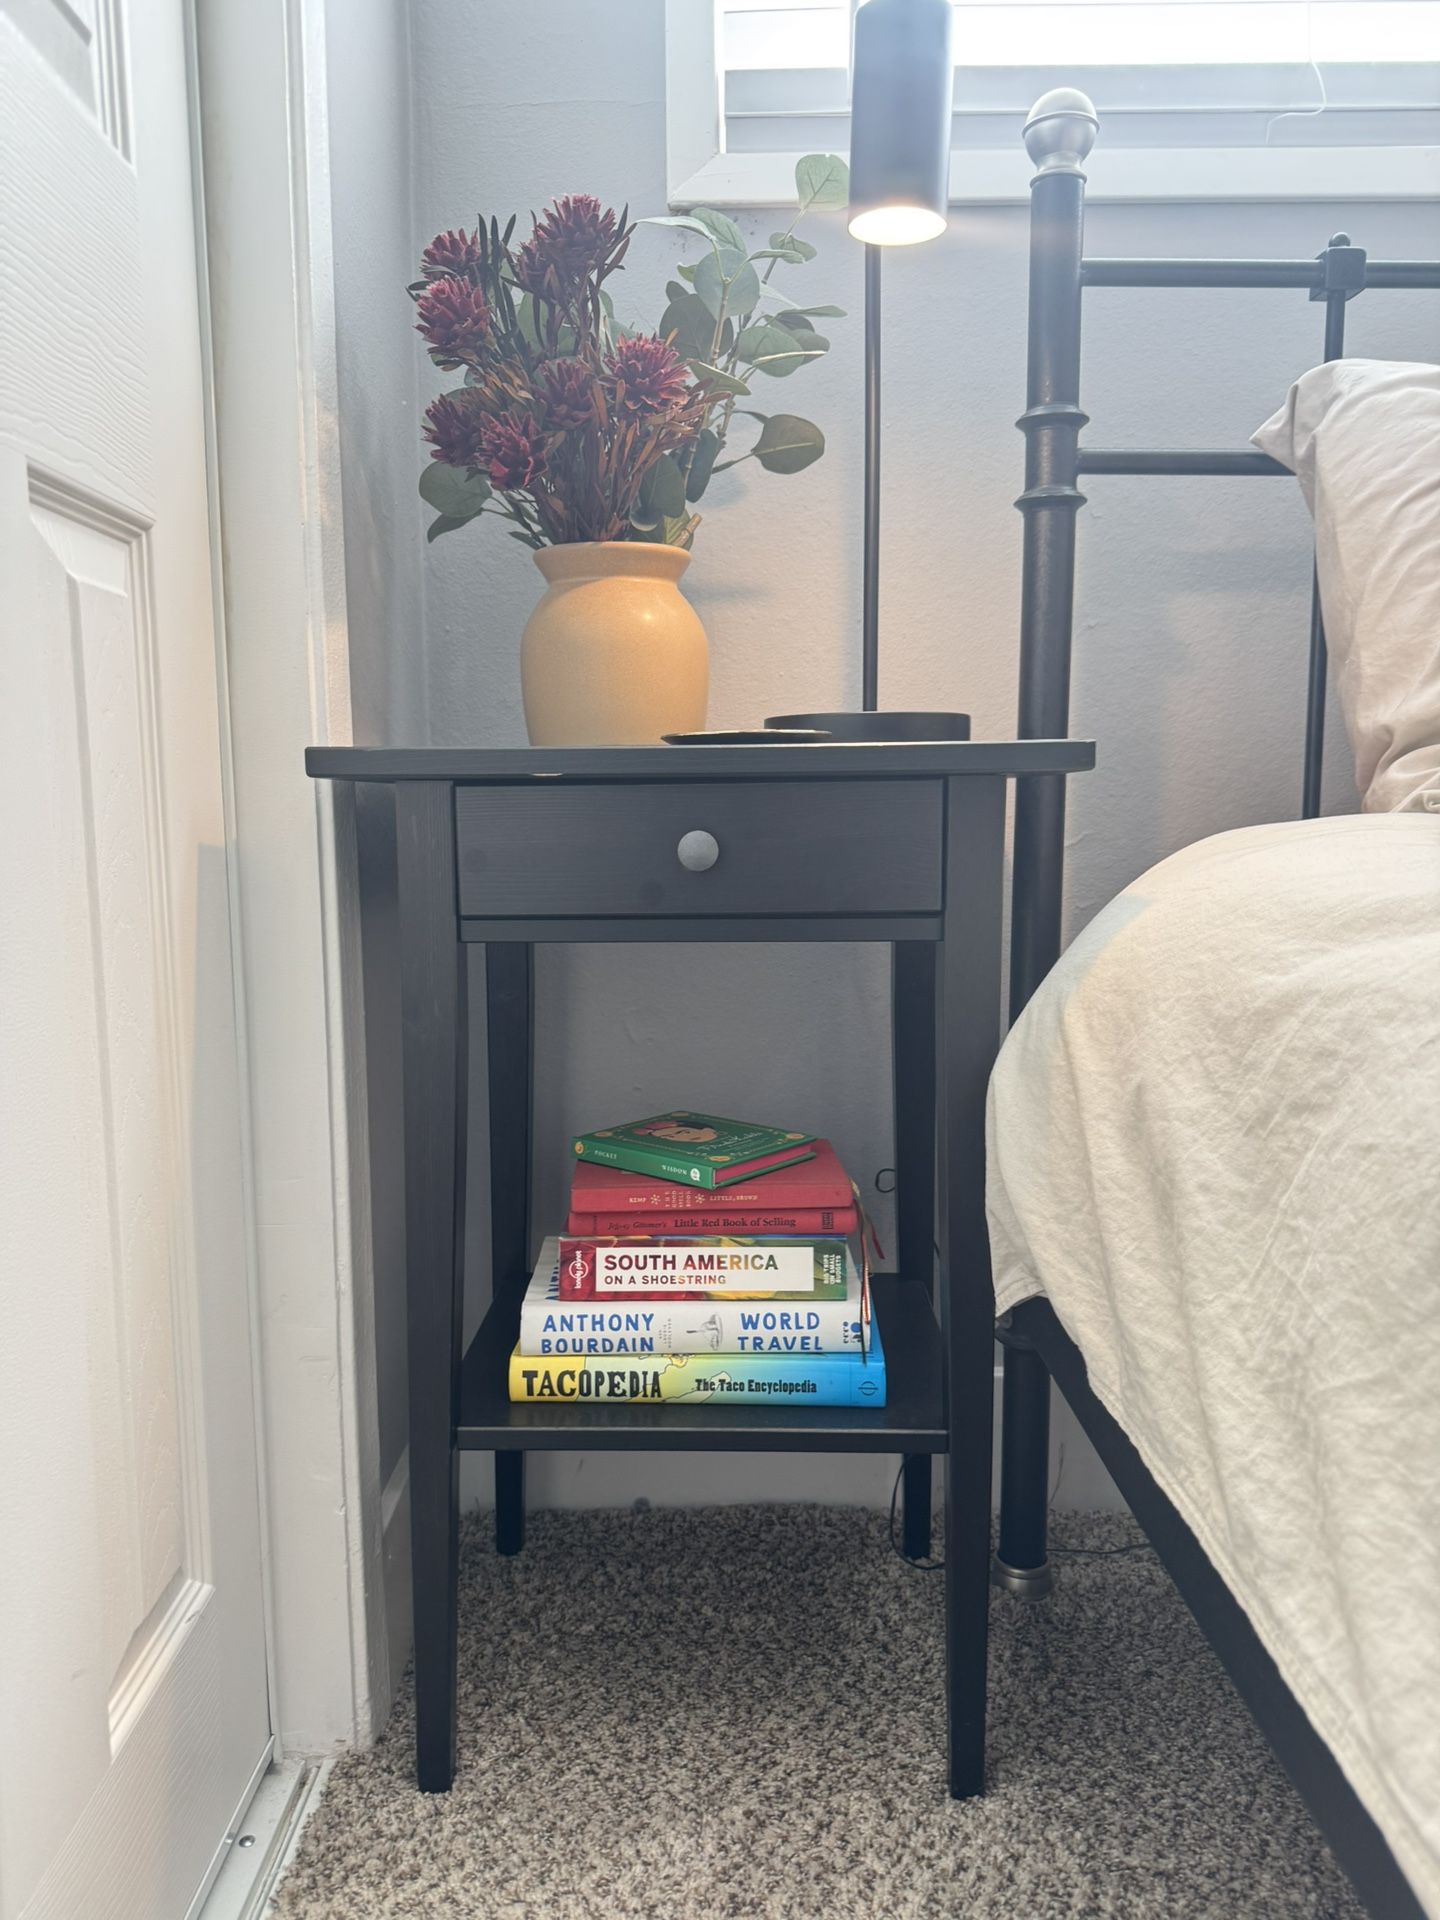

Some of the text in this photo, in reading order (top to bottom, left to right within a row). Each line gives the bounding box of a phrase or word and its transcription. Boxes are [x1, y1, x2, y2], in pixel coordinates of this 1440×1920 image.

[594, 1150, 617, 1160] POCKET
[674, 1218, 698, 1228] Little
[701, 1218, 720, 1227] Red
[722, 1217, 748, 1227] Book
[750, 1217, 762, 1227] of
[763, 1217, 796, 1229] Selling
[574, 1250, 584, 1289] lonely planet
[604, 1254, 779, 1271] SOUTH AMERICA
[604, 1275, 727, 1285] ON A SHOESTRING
[829, 1274, 836, 1285] ON
[542, 1313, 655, 1332] ANTHONY
[740, 1312, 821, 1330] WORLD
[541, 1337, 655, 1354] BOURDAIN
[738, 1336, 823, 1351] TRAVEL
[522, 1369, 662, 1398] TACOPEDIA
[695, 1379, 817, 1395] The Taco Encyclopedia
